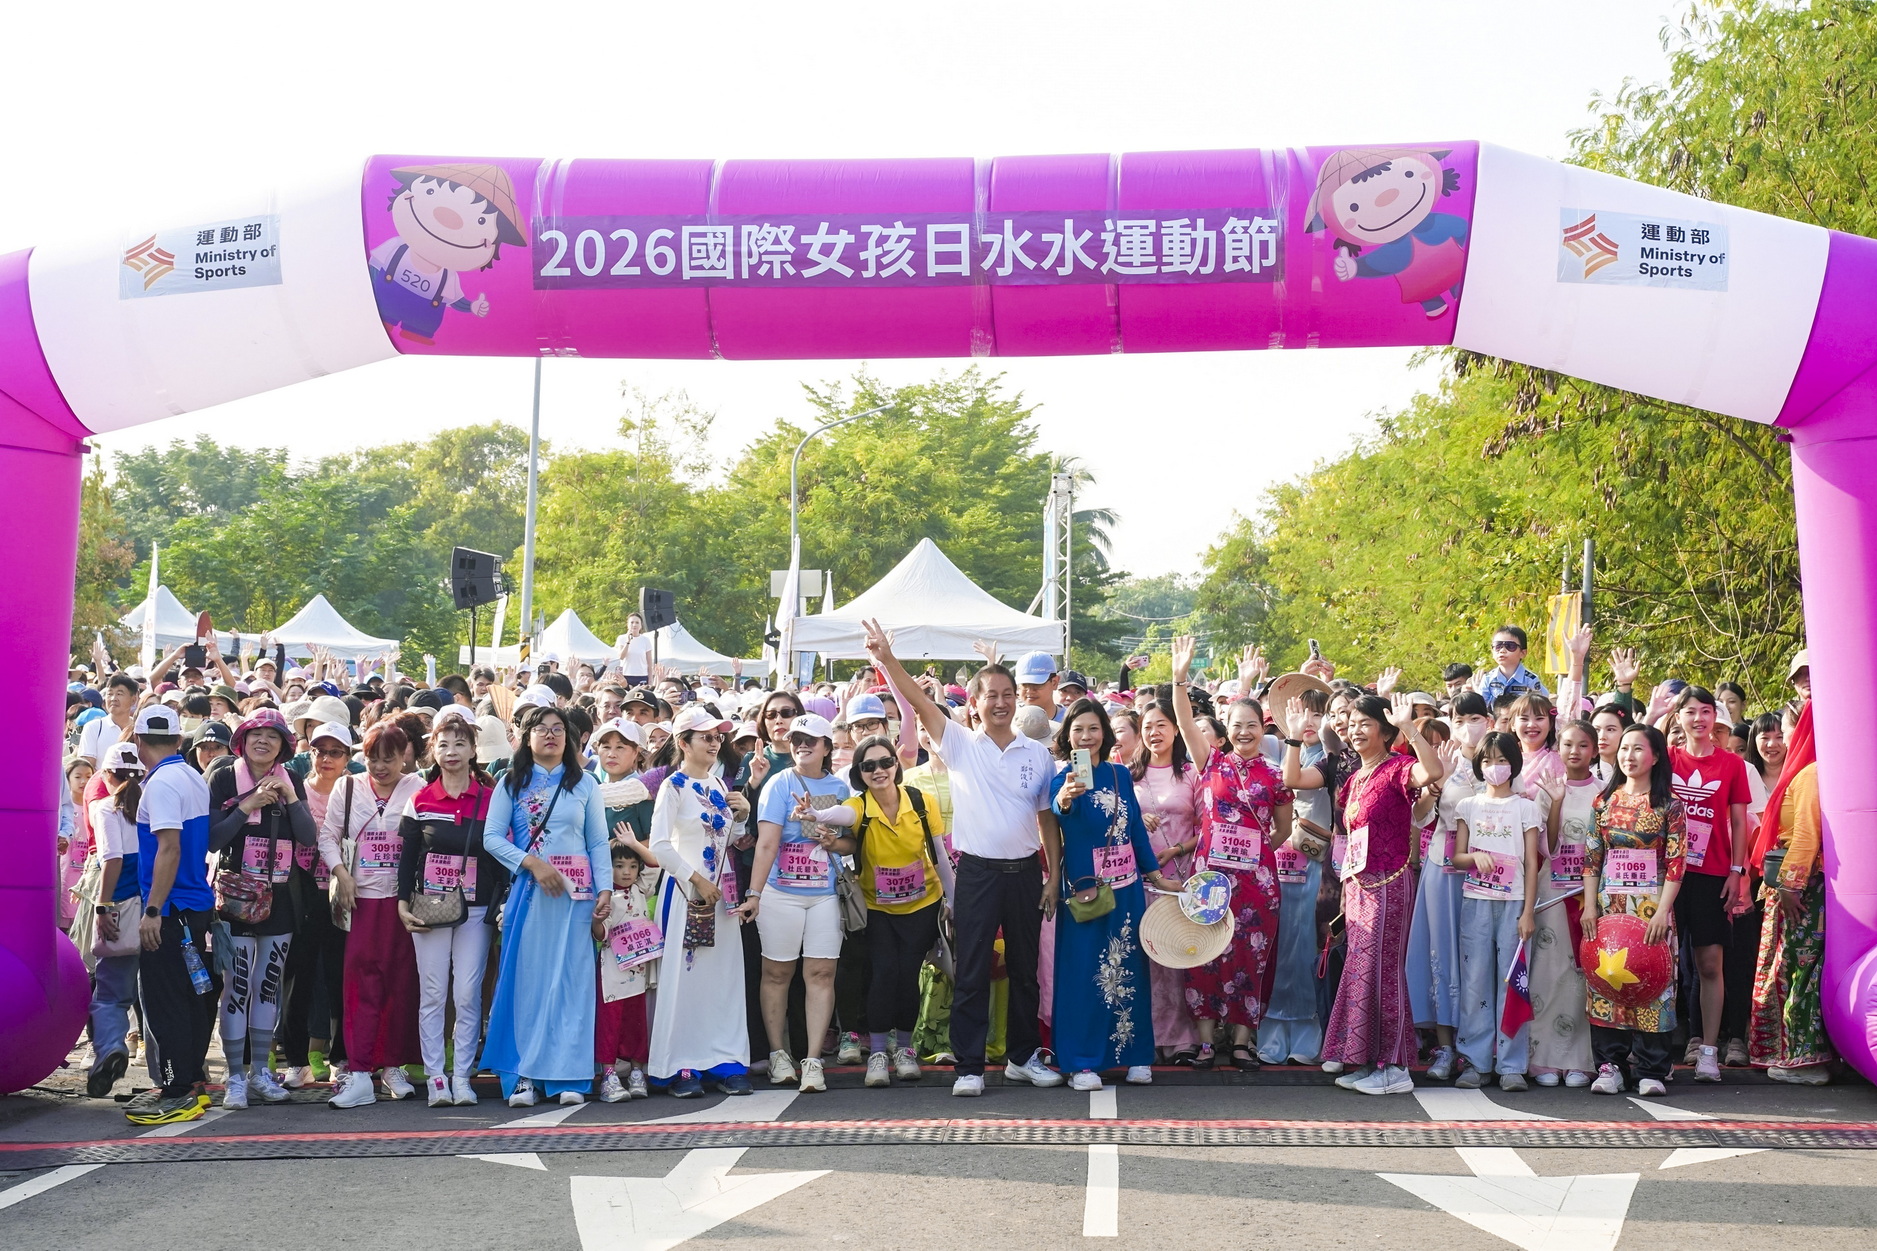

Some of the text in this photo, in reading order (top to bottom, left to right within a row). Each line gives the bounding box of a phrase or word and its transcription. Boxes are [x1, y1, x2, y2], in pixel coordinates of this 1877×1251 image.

[196, 223, 262, 246] 運動部
[1640, 223, 1710, 245] 運動部
[195, 245, 276, 264] Ministry of
[539, 216, 1279, 280] 2026國際女孩日水水運動節
[1640, 247, 1725, 265] Ministry of
[194, 264, 246, 280] Sports
[1638, 262, 1693, 277] Sports
[400, 269, 430, 292] 520
[1682, 801, 1714, 818] idas
[371, 843, 402, 852] 30919
[1221, 836, 1251, 848] 31045
[254, 850, 283, 860] 309
[1105, 855, 1132, 869] 31247
[1277, 852, 1297, 861] 059
[1561, 857, 1584, 866] 3103
[435, 867, 461, 877] 3089
[1615, 862, 1646, 871] 31069
[886, 874, 915, 886] 30757
[620, 929, 651, 945] 31066
[227, 945, 249, 1015] 100%
[260, 940, 289, 1005] 100%
